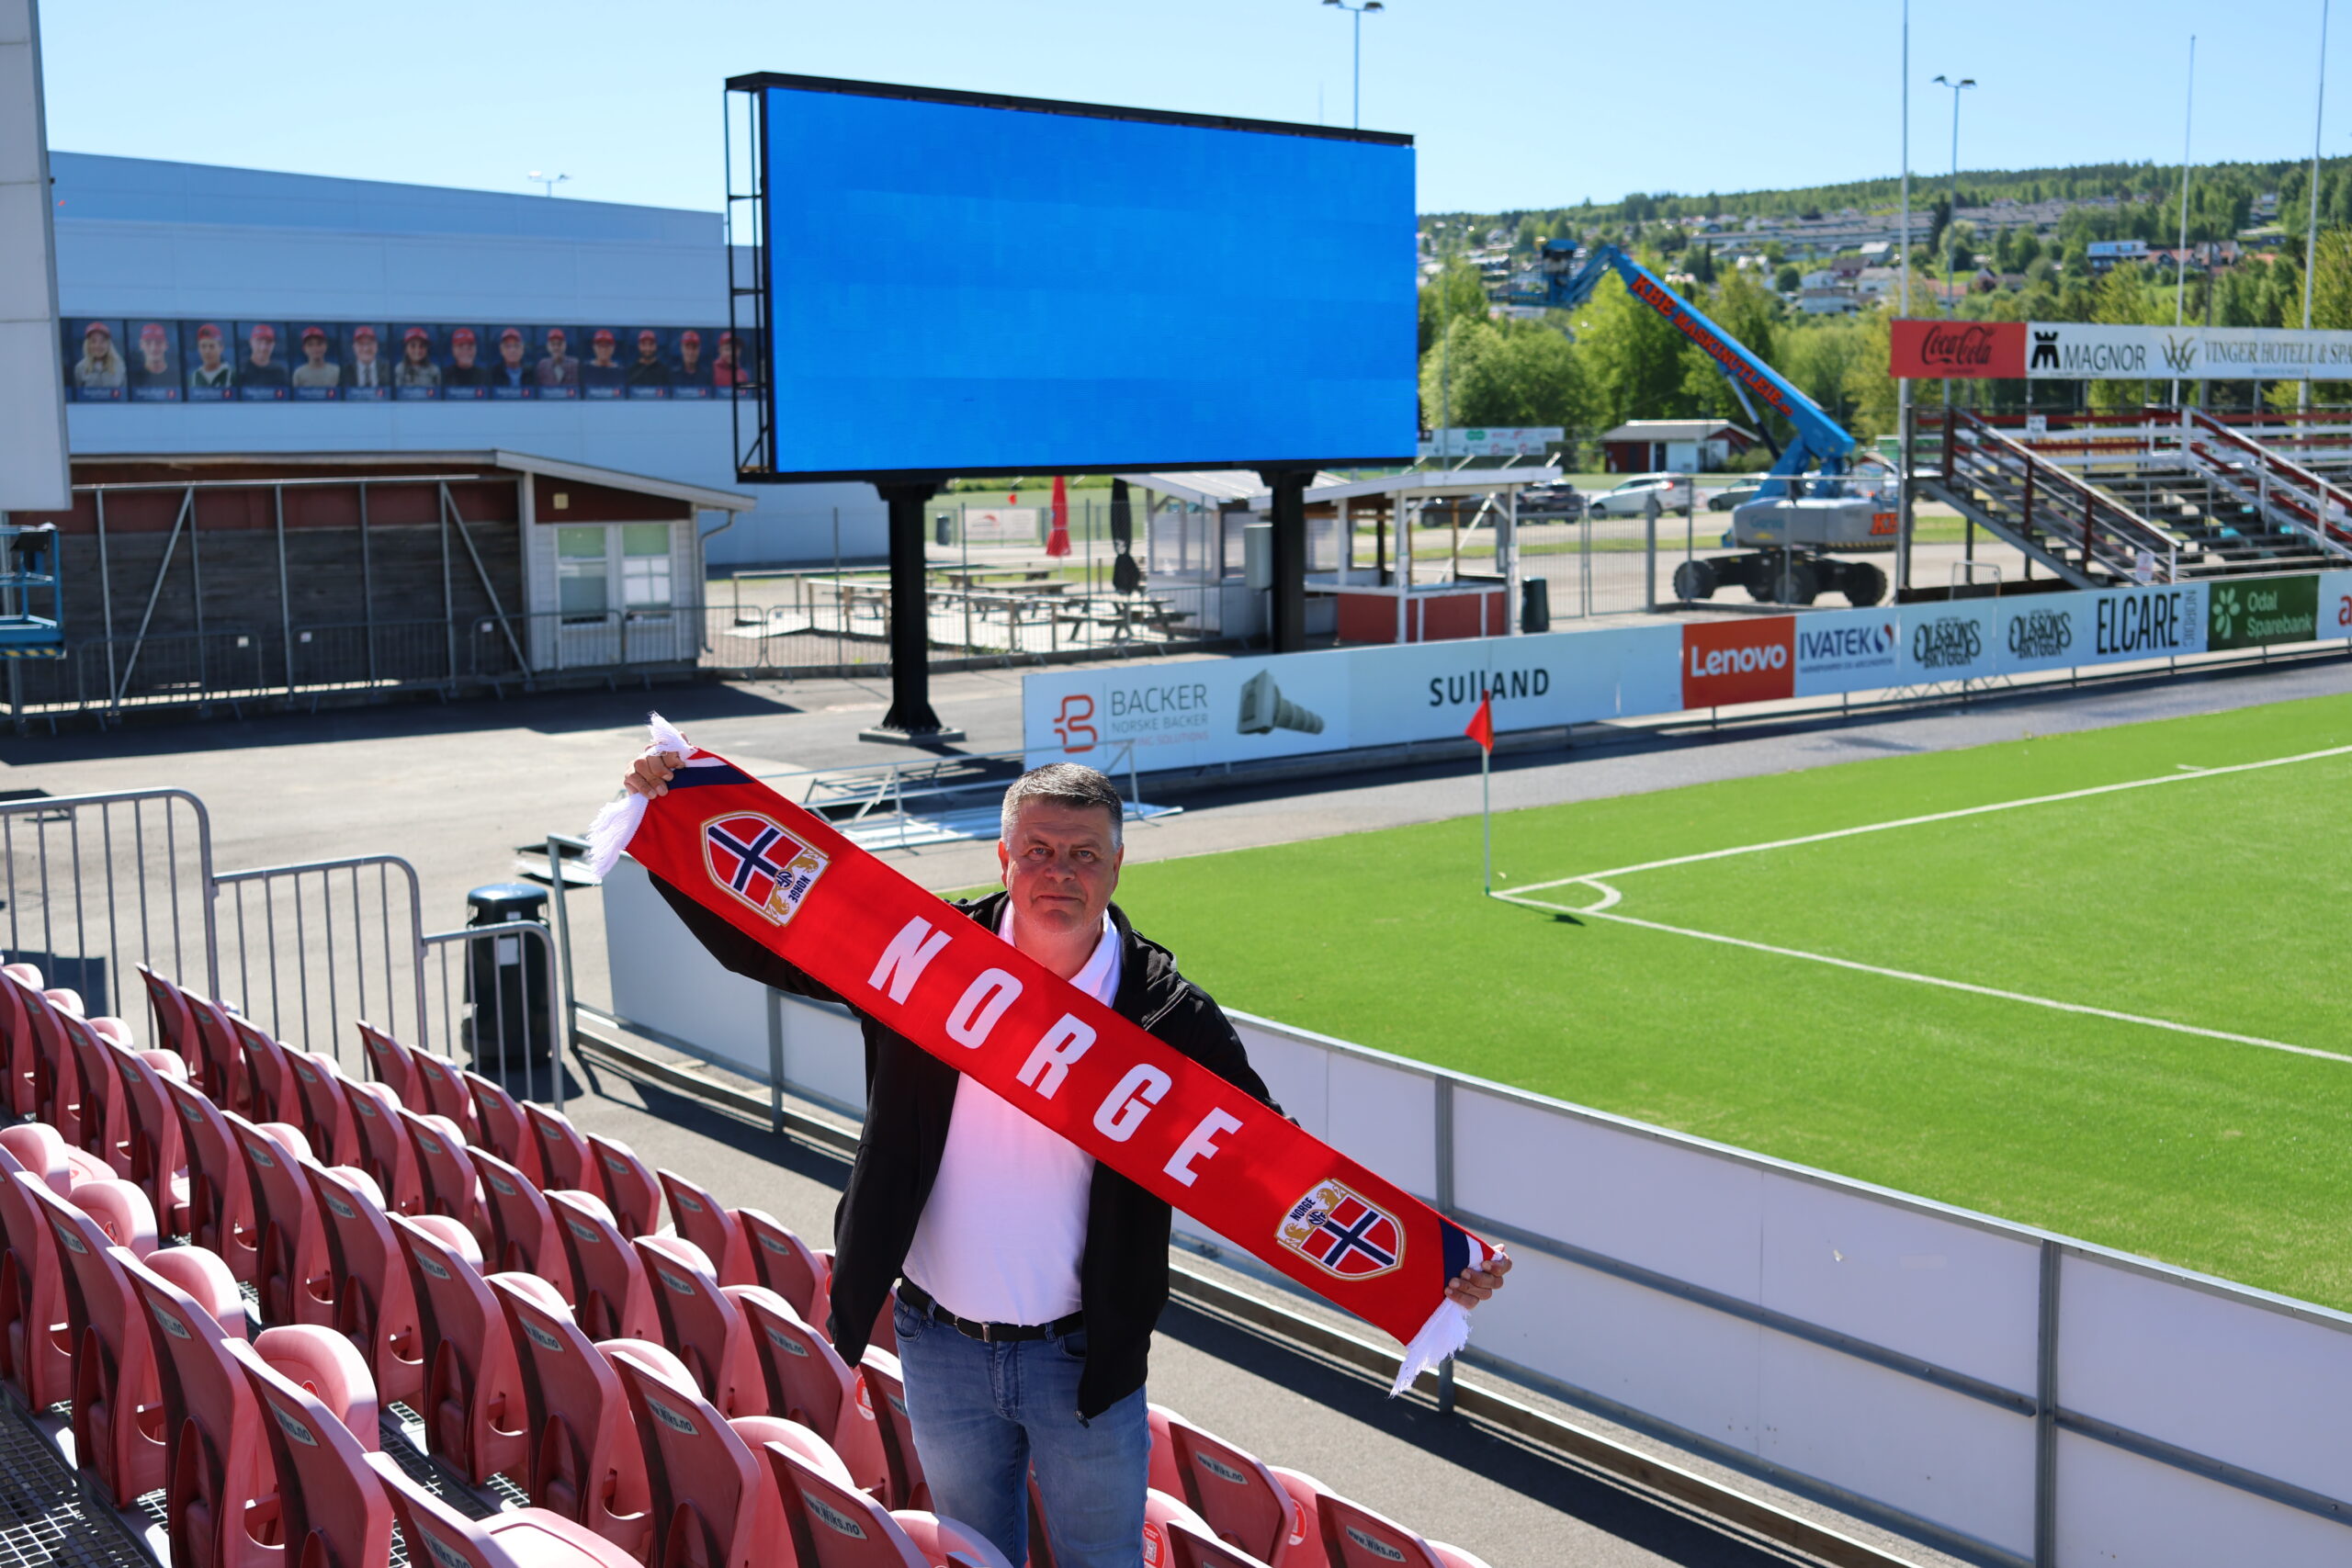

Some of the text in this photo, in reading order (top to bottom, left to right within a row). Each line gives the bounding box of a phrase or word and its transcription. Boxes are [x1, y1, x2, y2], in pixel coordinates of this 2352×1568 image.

[1631, 274, 1678, 317] KBE
[2064, 344, 2146, 371] MAGNOR
[2261, 342, 2315, 364] HOTELL
[2247, 590, 2278, 613] Odal
[2097, 592, 2181, 655] ELCARE
[2246, 613, 2312, 638] Sparebank
[1800, 626, 1871, 660] IVATEK
[1691, 645, 1787, 677] Lenovo
[1112, 684, 1208, 716] BACKER
[1112, 714, 1208, 734] NORSKE BACKER
[787, 874, 811, 904] NORGE
[867, 915, 1244, 1188] NORGE
[1289, 1197, 1316, 1222] NORGE
[1347, 1529, 1401, 1560] www.Wiks.no
